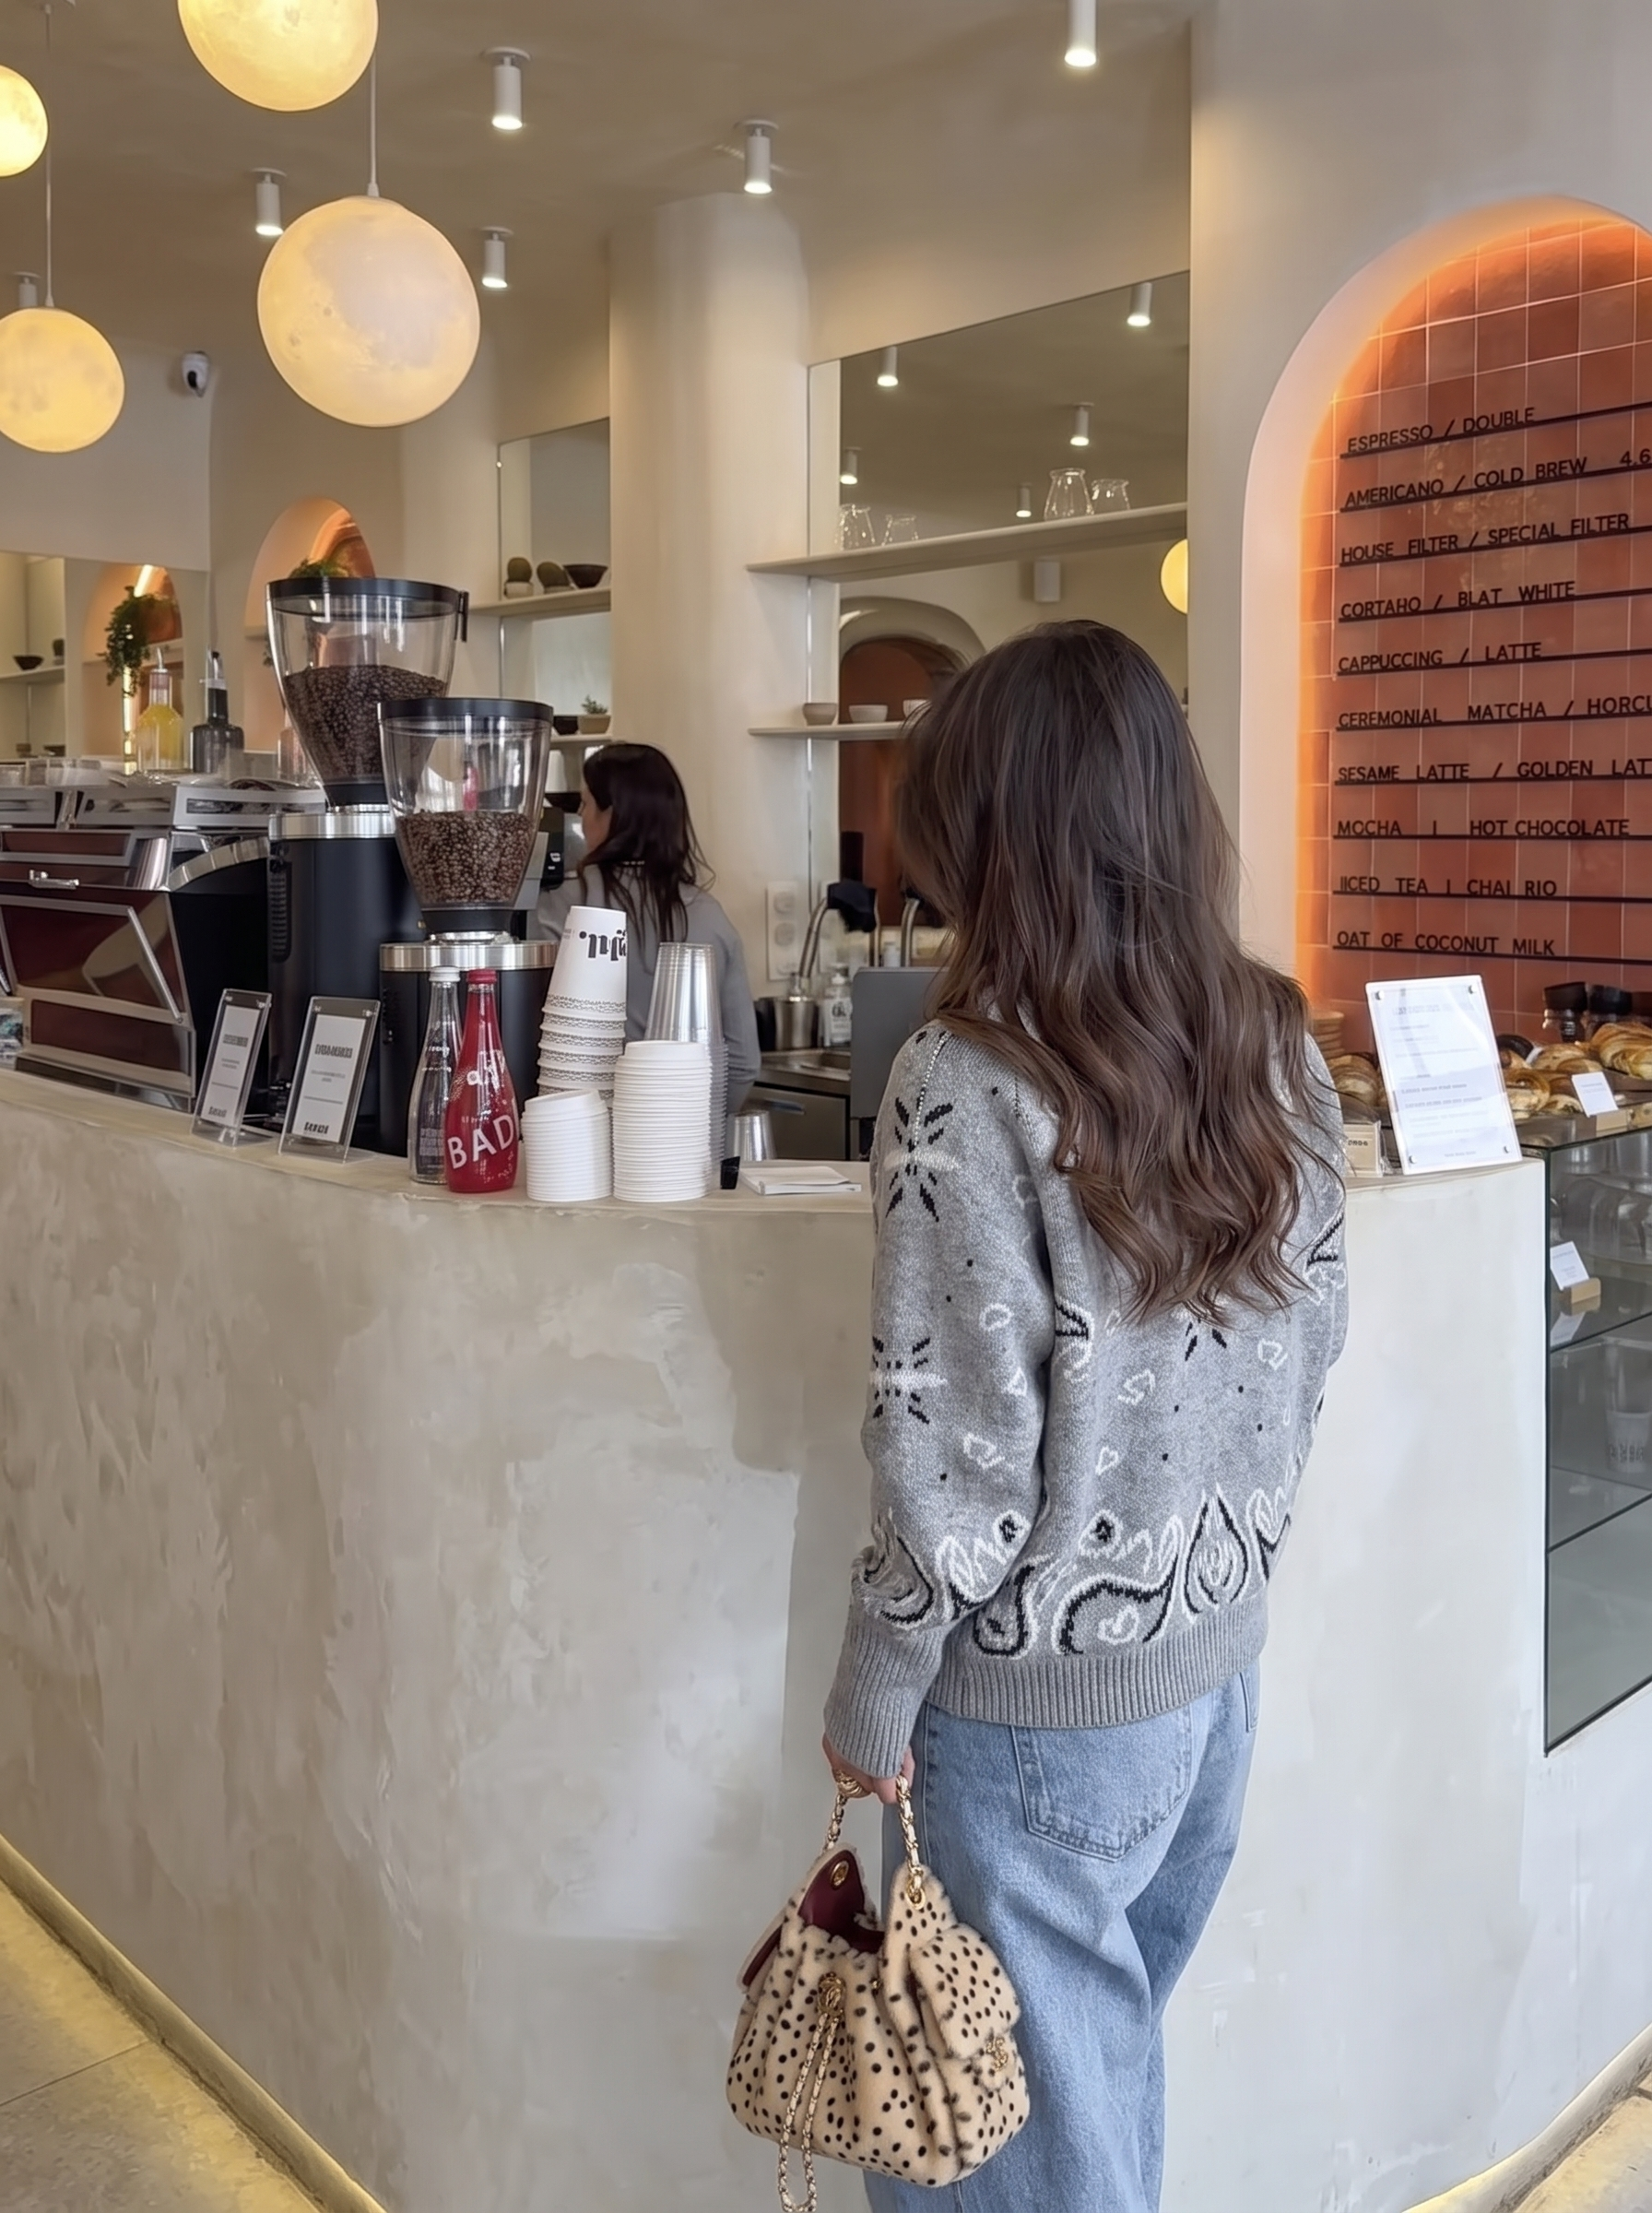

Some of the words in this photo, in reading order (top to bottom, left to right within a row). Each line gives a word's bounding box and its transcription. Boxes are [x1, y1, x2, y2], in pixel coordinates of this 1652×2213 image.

[1348, 424, 1434, 453] ESPRESSO
[1445, 419, 1456, 437] /
[1462, 407, 1535, 433] DOUBLE
[1345, 479, 1445, 508] AMERICANO
[1454, 474, 1466, 493] /
[1474, 467, 1524, 489] COLD
[1535, 456, 1587, 479] BREW
[1341, 542, 1394, 564] HOUSE
[1408, 535, 1458, 555] FILTER
[1469, 531, 1479, 549] /
[1488, 522, 1560, 544] SPECIAL
[1570, 513, 1630, 535] FILTER
[1434, 594, 1443, 610] /
[1457, 588, 1503, 608] BLAT
[1518, 581, 1575, 601] WHITE
[1459, 647, 1469, 664] /
[1485, 642, 1541, 662] LATTE
[1339, 707, 1443, 728] CEREMONIAL
[1468, 702, 1547, 720] MATCHA
[1564, 700, 1575, 716] /
[1338, 765, 1399, 781] SESAME
[1416, 763, 1469, 780] LATTE
[1493, 763, 1503, 778] /
[1516, 760, 1593, 778] GOLDEN
[1338, 820, 1402, 835] MOCHA
[1469, 820, 1508, 835] HOT
[1515, 820, 1630, 836] CHOCOLATE
[1395, 878, 1428, 893] TEA
[1467, 880, 1512, 896] CHAI
[1525, 881, 1557, 896] RIO
[1337, 931, 1370, 947] OAT
[1381, 933, 1403, 948] OF
[1415, 934, 1499, 953] COCONUT
[1513, 939, 1555, 956] MILK
